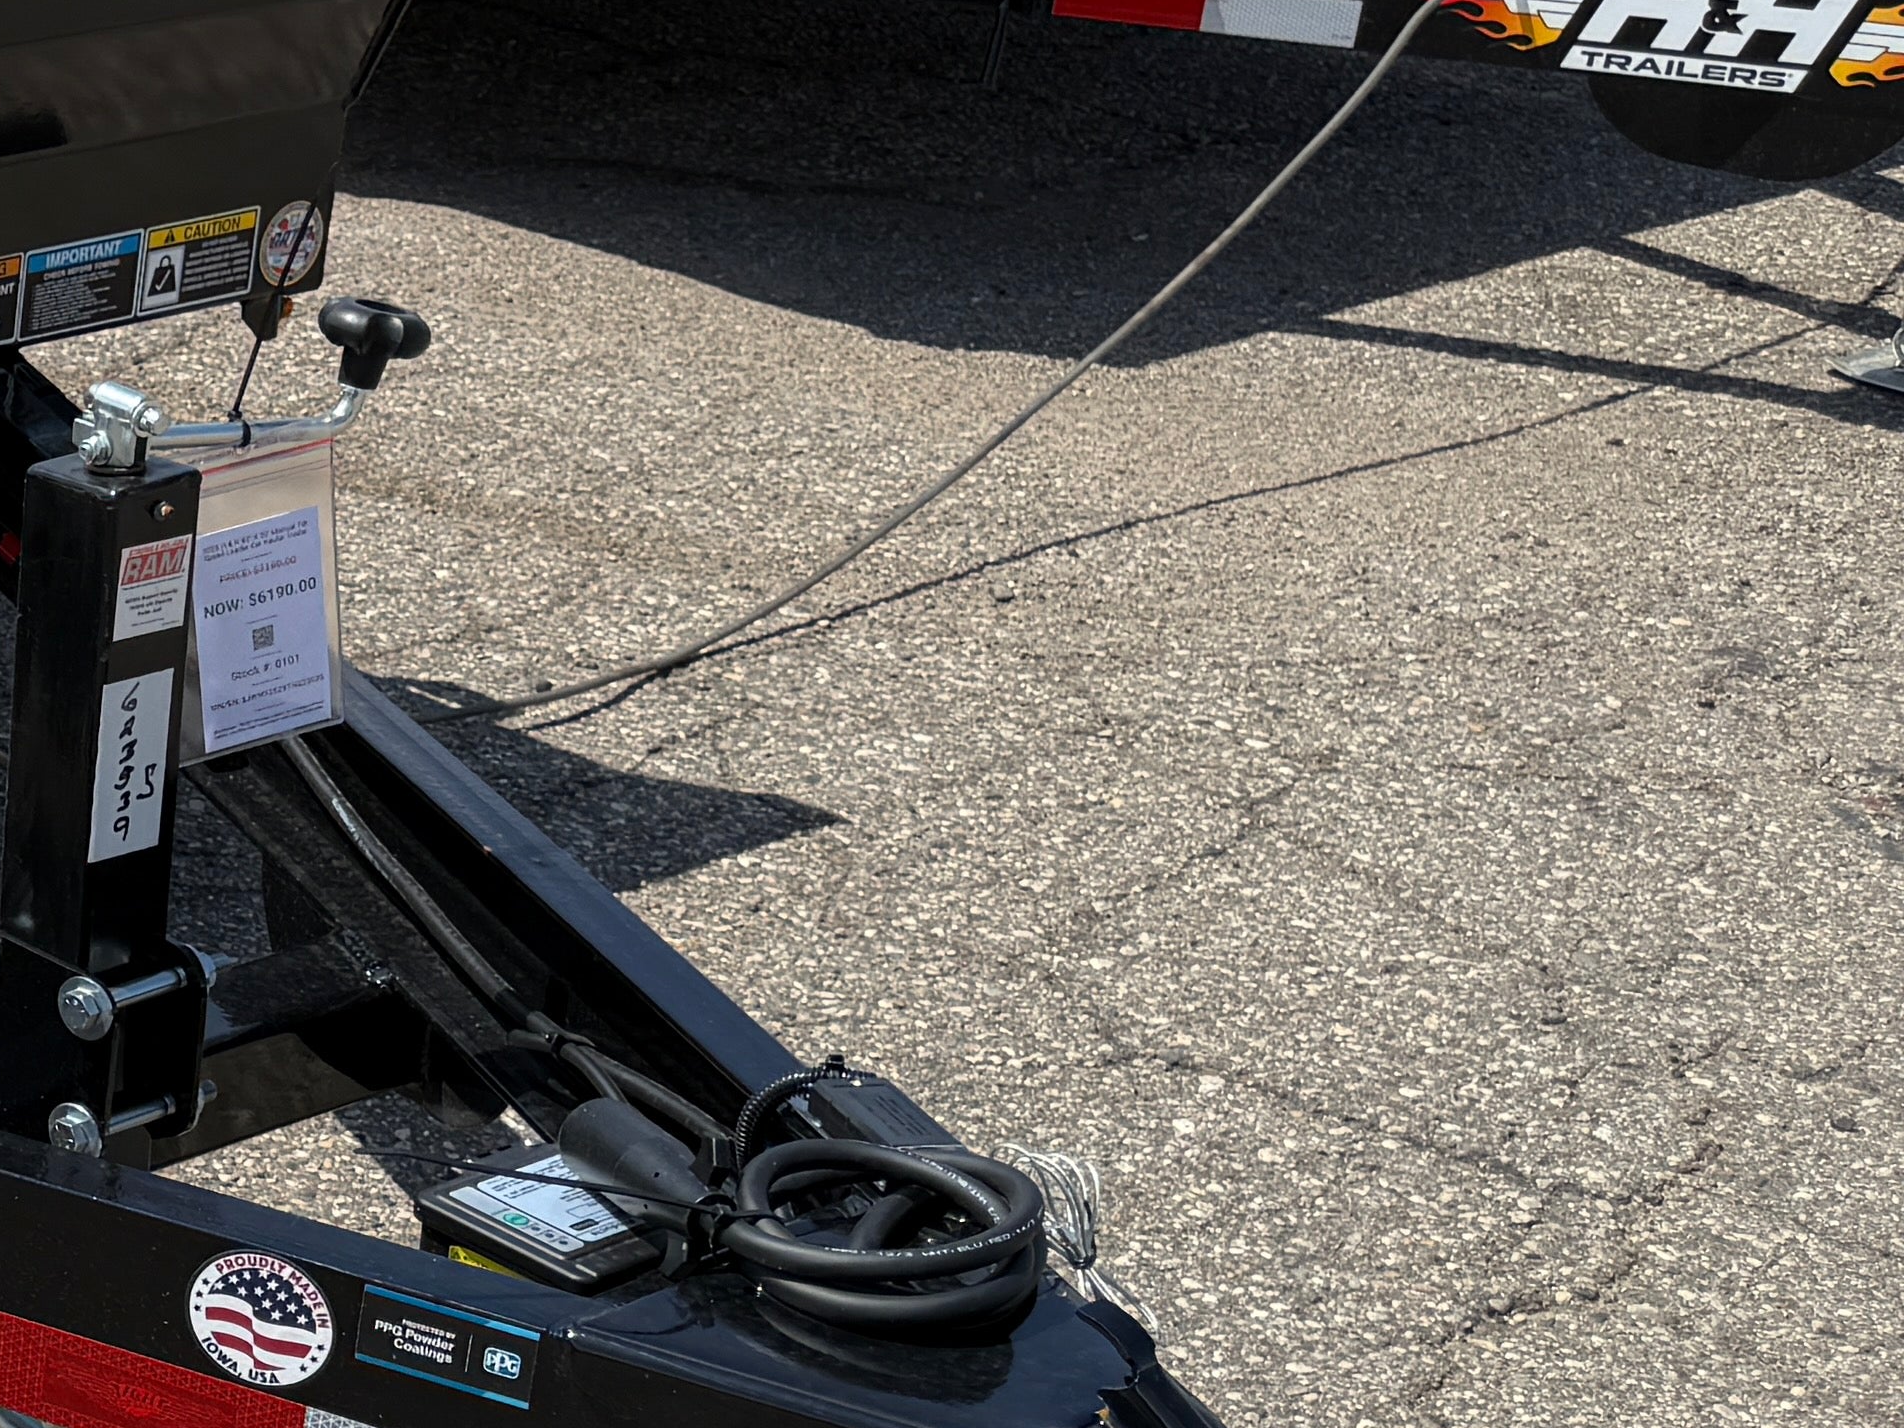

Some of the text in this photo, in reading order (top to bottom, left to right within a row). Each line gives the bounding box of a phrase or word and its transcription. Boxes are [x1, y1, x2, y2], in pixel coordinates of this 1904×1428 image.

[1581, 50, 1788, 88] TRAILERS
[183, 216, 241, 240] CAUTION
[45, 240, 123, 270] IMPORTANT
[122, 547, 185, 583] RAM
[203, 598, 244, 620] NOW:
[248, 576, 317, 607] $6190.00
[275, 653, 300, 669] 0101
[215, 1255, 330, 1330] PROUDLY MADE IN
[374, 1319, 456, 1352] PPG Powder
[402, 1319, 444, 1337] PROTECTED
[202, 1337, 281, 1384] IOWA, USA
[393, 1337, 453, 1364] Coatings
[486, 1352, 517, 1373] PPG
